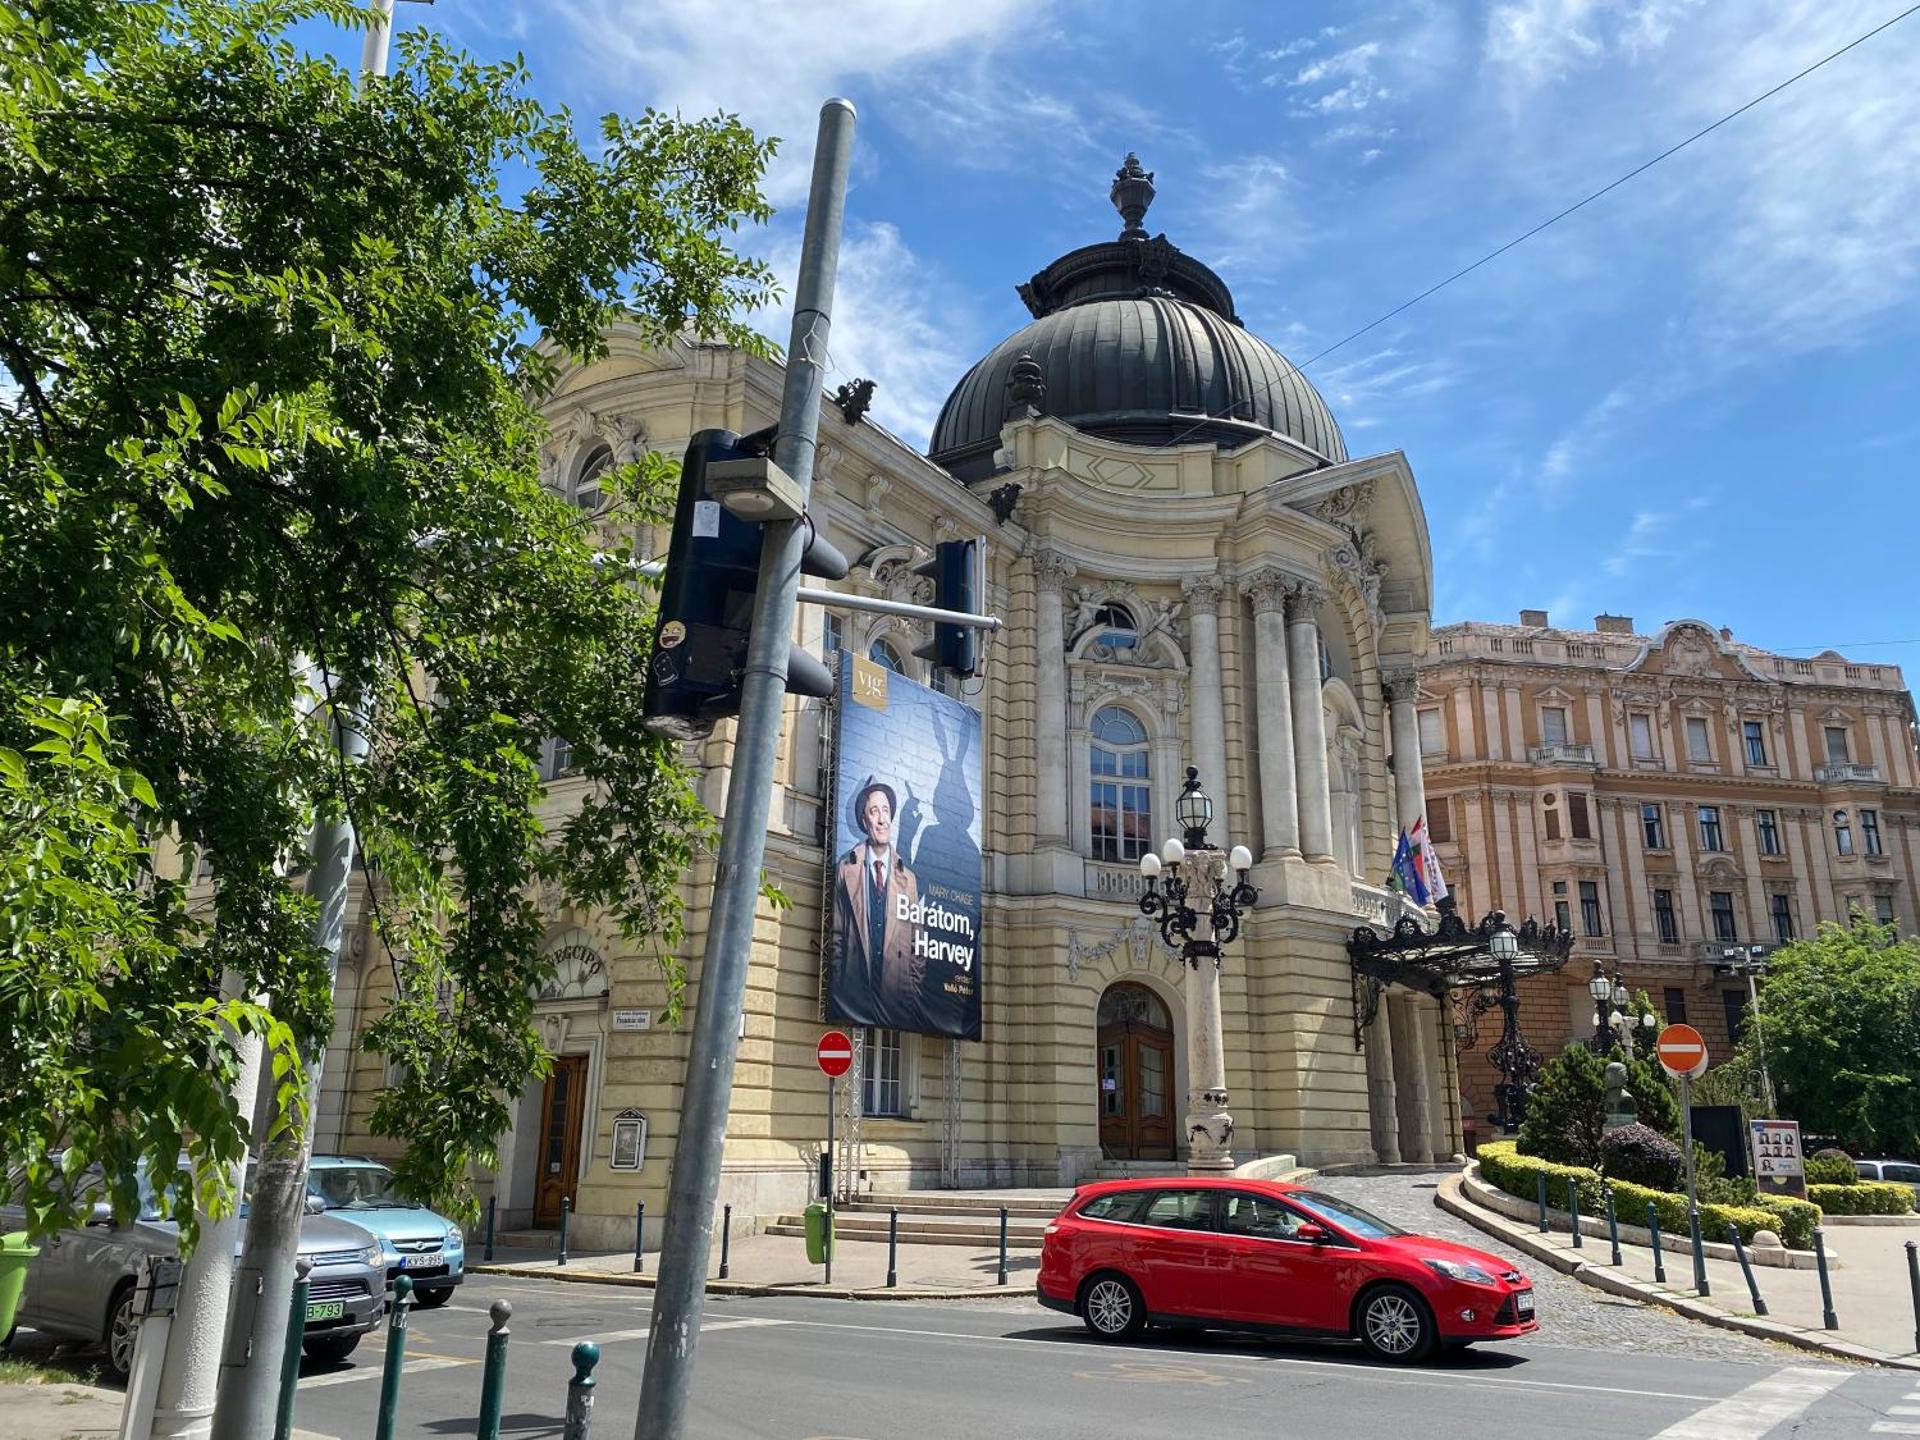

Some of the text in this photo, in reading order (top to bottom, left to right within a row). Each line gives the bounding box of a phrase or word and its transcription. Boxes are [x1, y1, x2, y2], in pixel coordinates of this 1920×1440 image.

[896, 893, 975, 941] Barátom,
[914, 929, 974, 972] Harvey
[306, 1303, 342, 1318] B-793
